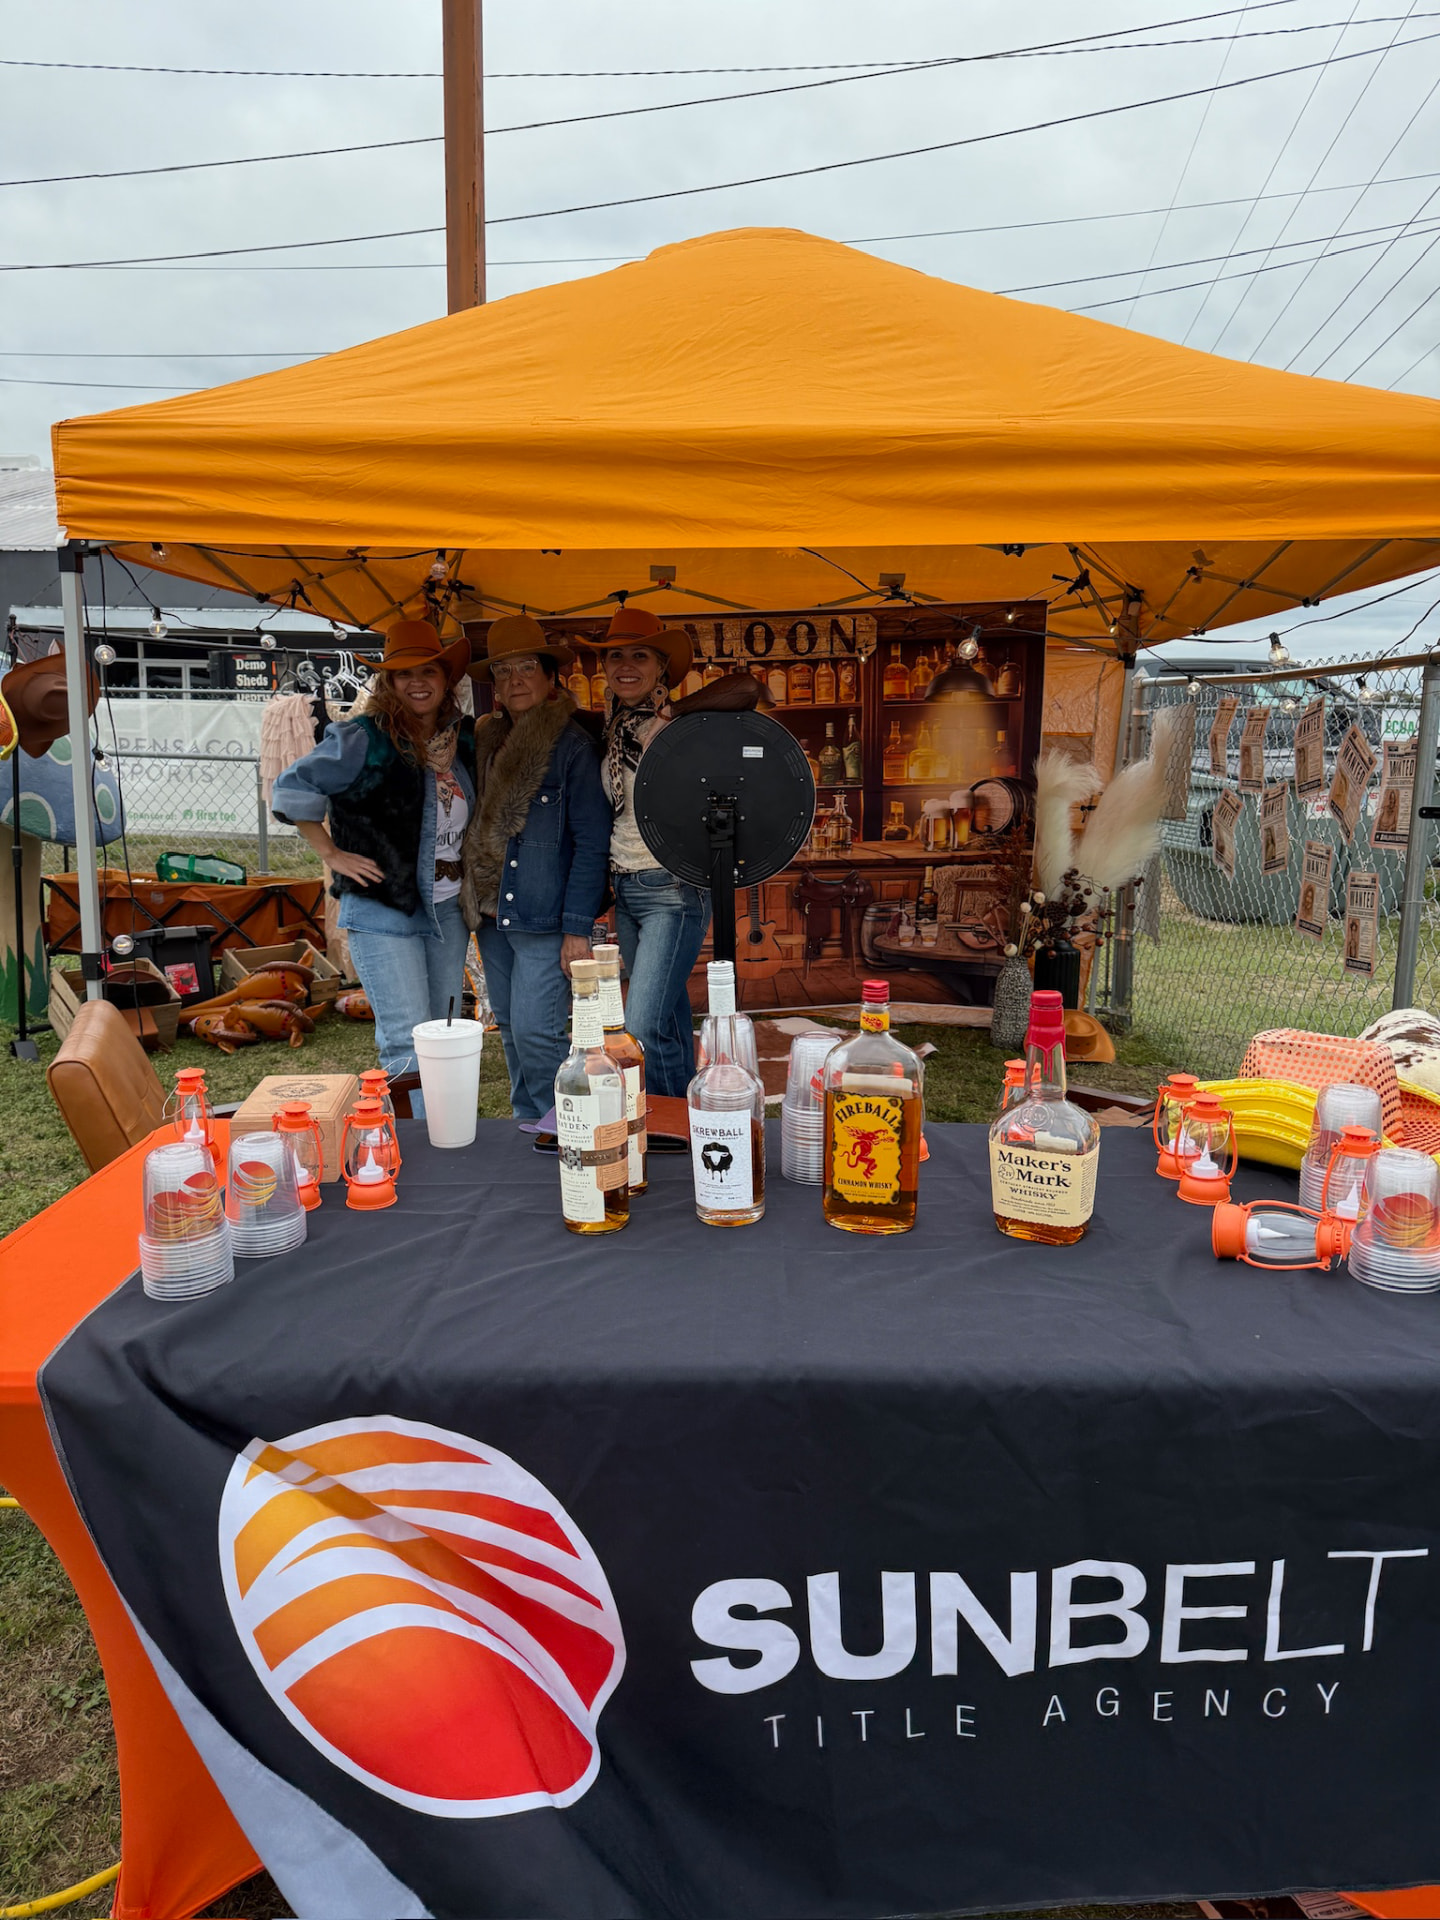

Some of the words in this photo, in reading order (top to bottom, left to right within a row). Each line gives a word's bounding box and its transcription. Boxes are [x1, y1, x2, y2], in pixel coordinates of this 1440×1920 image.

[684, 617, 857, 659] ALOON
[235, 659, 267, 671] Demo
[236, 674, 269, 687] Sheds
[118, 737, 258, 755] PENSACOL
[115, 762, 215, 783] SPORTS
[1342, 743, 1366, 785] WANTED
[835, 1102, 898, 1128] FIREBALL
[692, 1124, 744, 1137] SKREWBALL
[997, 1150, 1071, 1172] Maker's
[838, 1178, 867, 1188] CINNAMON
[869, 1181, 892, 1190] WHISKY
[1016, 1169, 1071, 1188] Mark
[1009, 1186, 1057, 1200] WHISKY
[690, 1549, 1429, 1695] SUNBELT
[763, 1705, 976, 1749] TITLE
[1042, 1681, 1340, 1727] AGENCY
